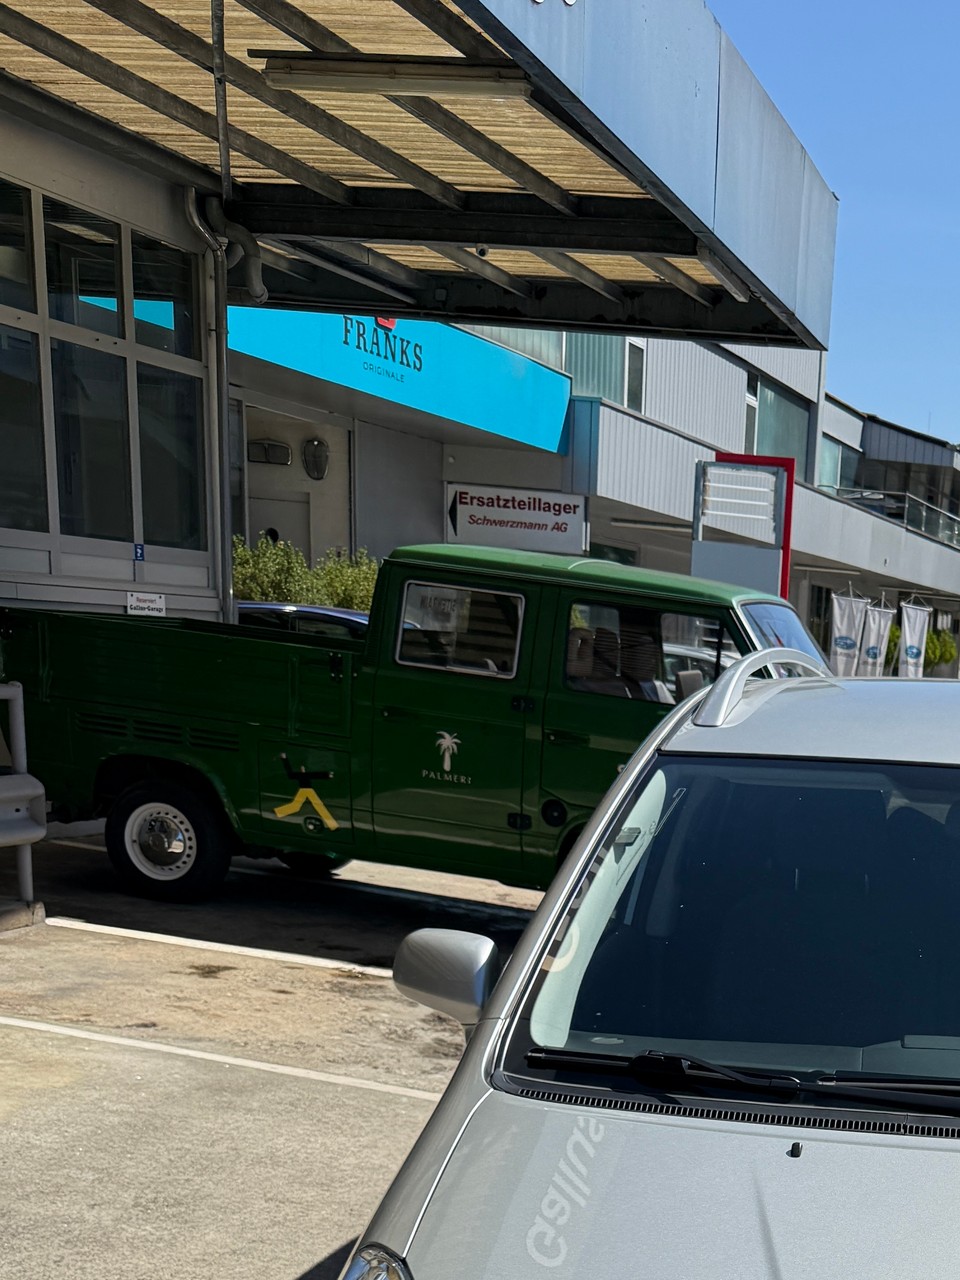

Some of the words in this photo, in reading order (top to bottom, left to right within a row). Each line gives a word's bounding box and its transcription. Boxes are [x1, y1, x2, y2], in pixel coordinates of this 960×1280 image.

[342, 314, 423, 372] FRANKS
[362, 361, 405, 383] ORIGINALE
[458, 491, 580, 516] Ersatzteillager
[467, 514, 548, 532] Schwerzmann
[551, 521, 569, 533] AG
